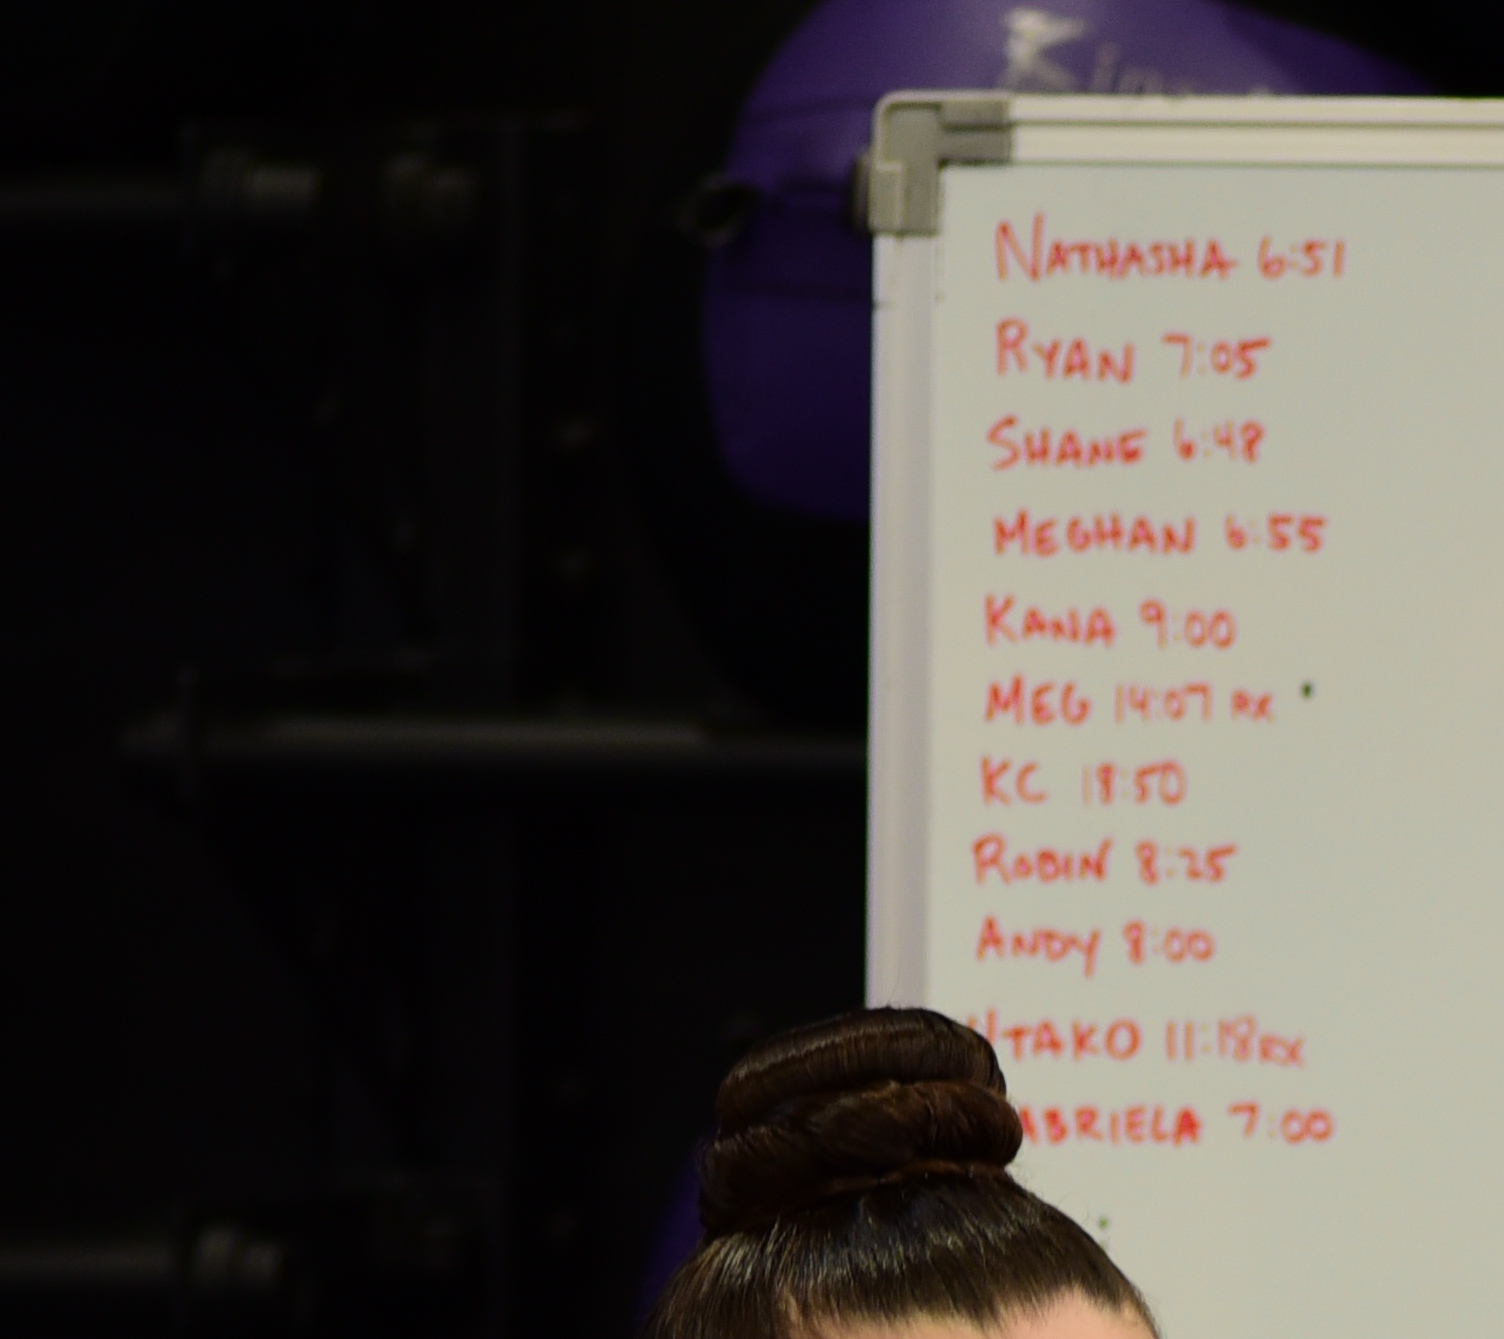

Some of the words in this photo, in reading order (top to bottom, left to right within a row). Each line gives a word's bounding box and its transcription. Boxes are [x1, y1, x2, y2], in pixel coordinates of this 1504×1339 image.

[995, 213, 1237, 282] NATHASHA
[1257, 237, 1346, 280] 6:51
[995, 316, 1135, 384] RYAN
[1162, 331, 1272, 381] 7:05
[986, 413, 1148, 472] SHANE
[992, 507, 1197, 559] MEGHAN
[1224, 512, 1328, 554] 6:55
[983, 594, 1118, 647] KANA
[1139, 598, 1237, 651] 9:00
[984, 672, 1093, 727] MEG
[1115, 680, 1213, 722] 14:07
[980, 756, 1048, 805] KC
[971, 832, 1114, 885] ROBIN
[1135, 838, 1238, 886] 8:25
[975, 914, 1102, 977] ANDY
[1227, 1100, 1336, 1145] 7:00
